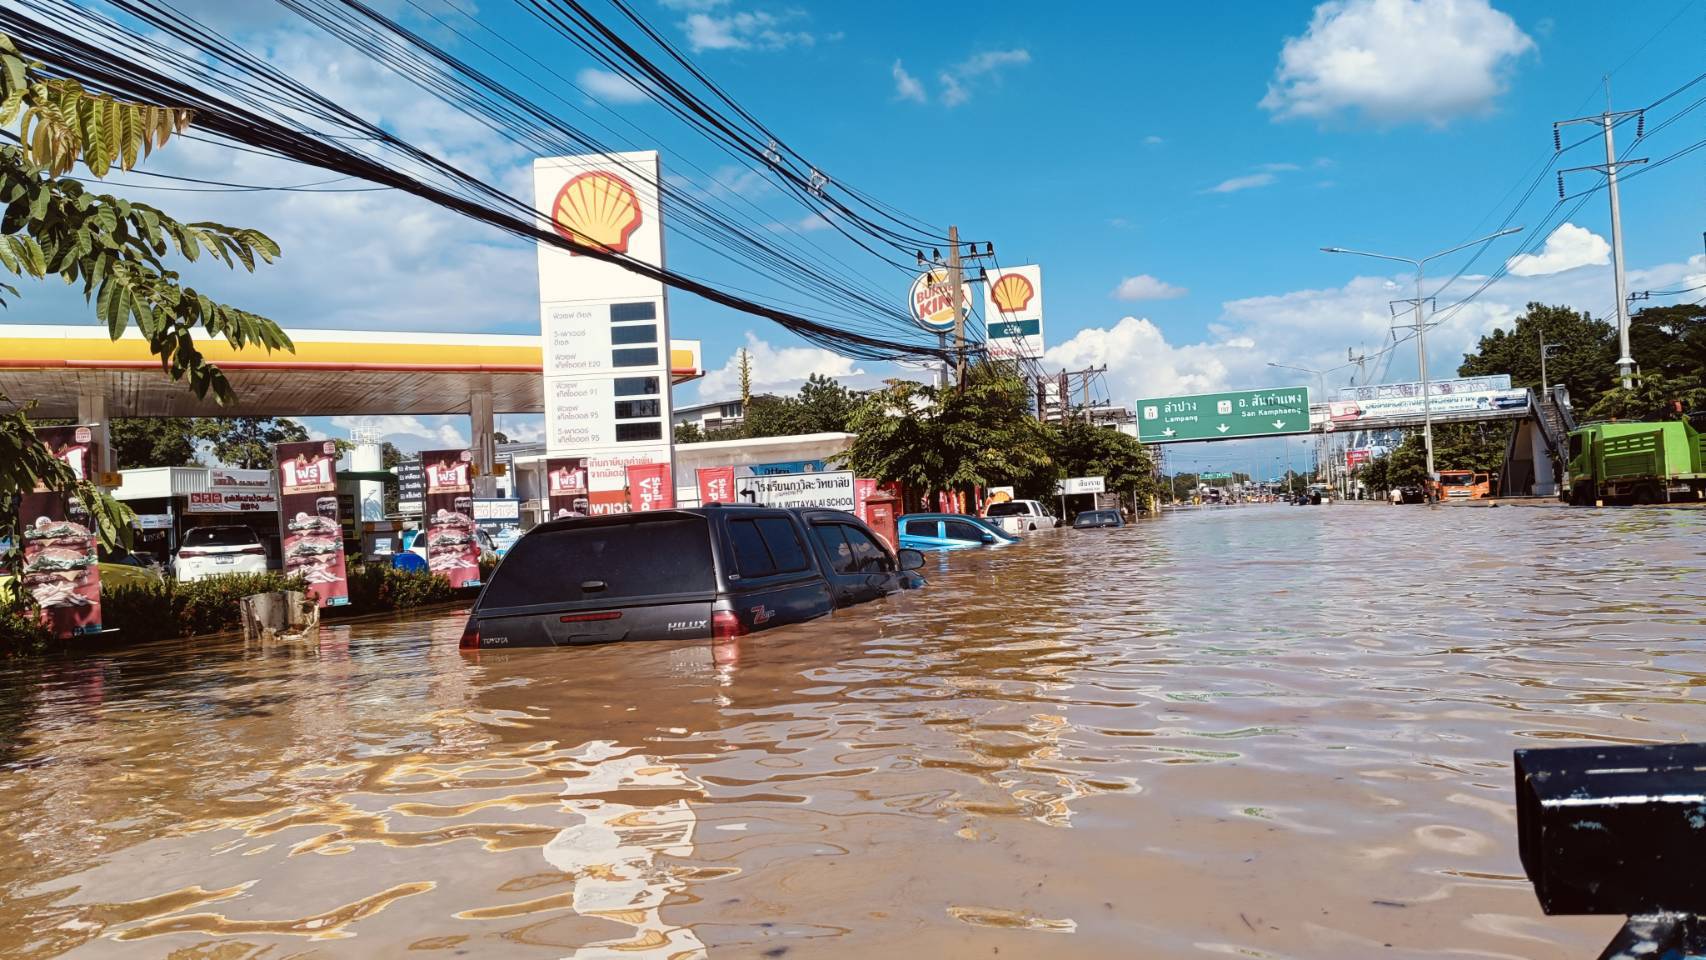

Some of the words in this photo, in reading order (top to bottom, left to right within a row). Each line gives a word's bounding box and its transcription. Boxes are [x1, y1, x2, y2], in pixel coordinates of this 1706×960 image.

[588, 360, 601, 368] E20
[1252, 392, 1302, 407] สันกำแพง
[1164, 401, 1197, 413] ลำปาง
[1258, 407, 1302, 417] Kamphaeng
[590, 411, 599, 419] 95
[1164, 415, 1198, 423] Lampang
[591, 434, 601, 442] 95
[652, 477, 663, 501] Shell
[719, 479, 728, 499] Shell
[827, 497, 854, 507] SCHOOL
[668, 619, 708, 632] HILUX
[483, 636, 508, 645] TOYOTA
